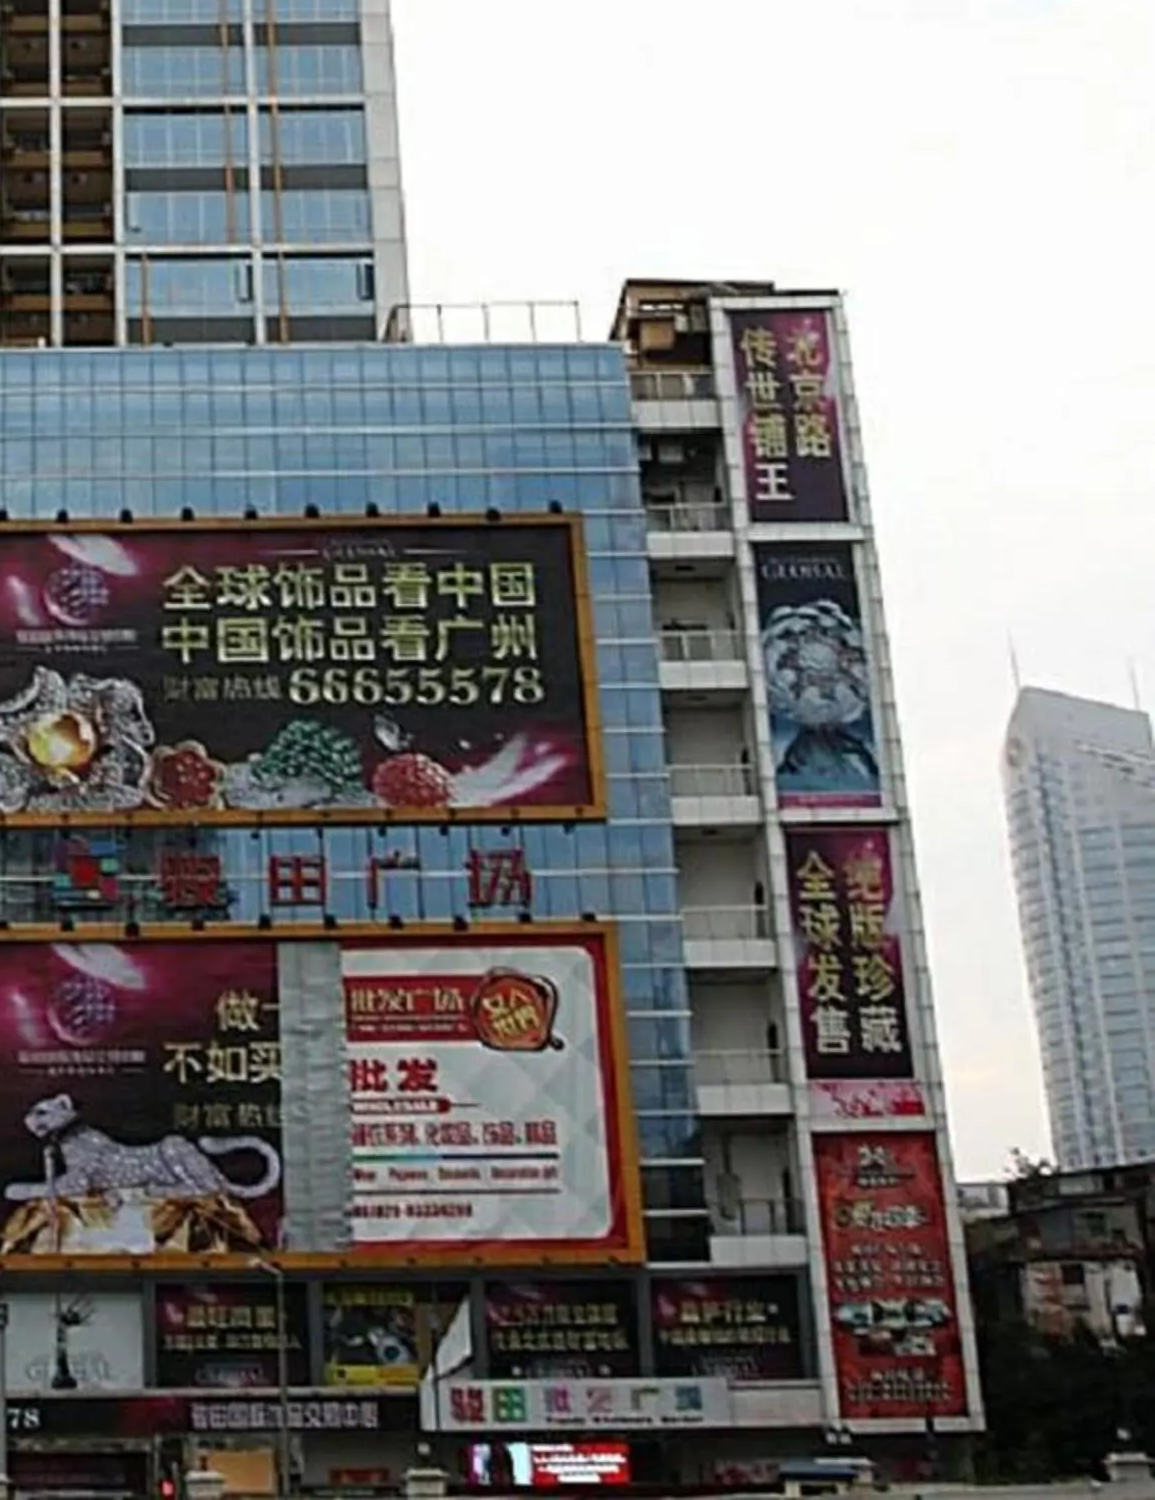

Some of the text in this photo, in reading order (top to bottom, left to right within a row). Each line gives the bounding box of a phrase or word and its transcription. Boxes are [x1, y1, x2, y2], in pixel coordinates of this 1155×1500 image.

[161, 562, 536, 611] 全球饰品看中国
[161, 615, 539, 663] 中国饰品看广州
[288, 667, 544, 706] 66655578
[796, 851, 850, 1054] 全球发售
[348, 1058, 439, 1093] 批发
